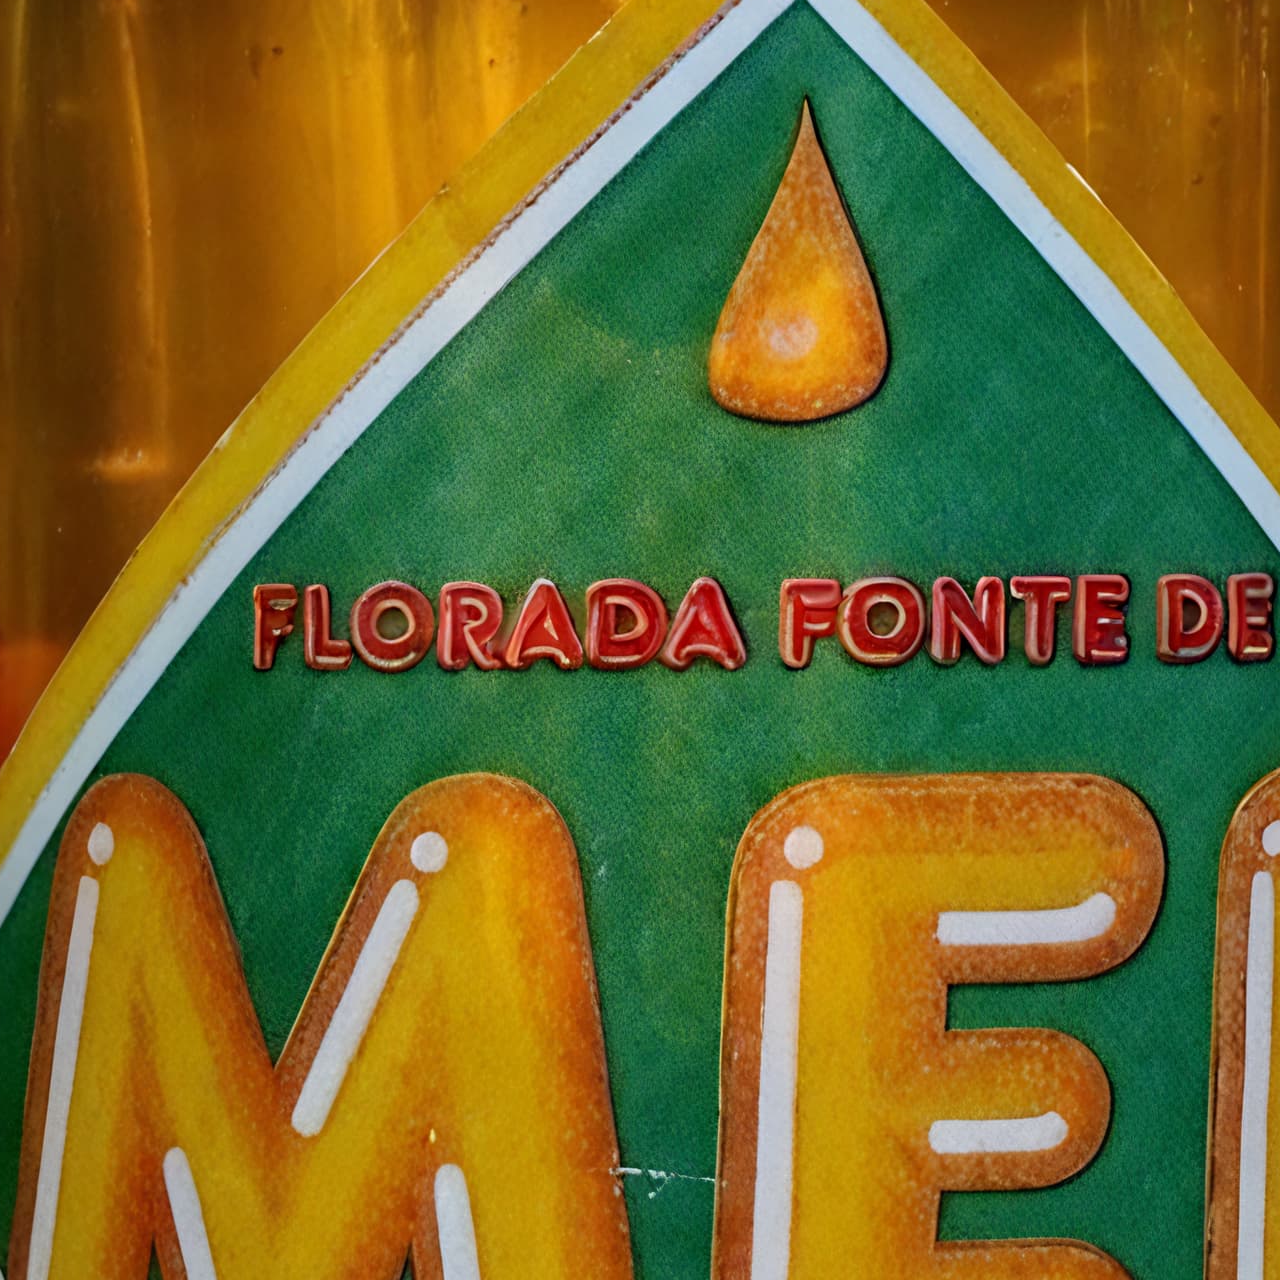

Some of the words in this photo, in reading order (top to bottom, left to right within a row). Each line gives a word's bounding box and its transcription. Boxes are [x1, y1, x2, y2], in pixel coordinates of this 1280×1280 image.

[251, 576, 746, 672] FLORADA
[778, 575, 1131, 670] FONTE
[1155, 572, 1276, 664] DE
